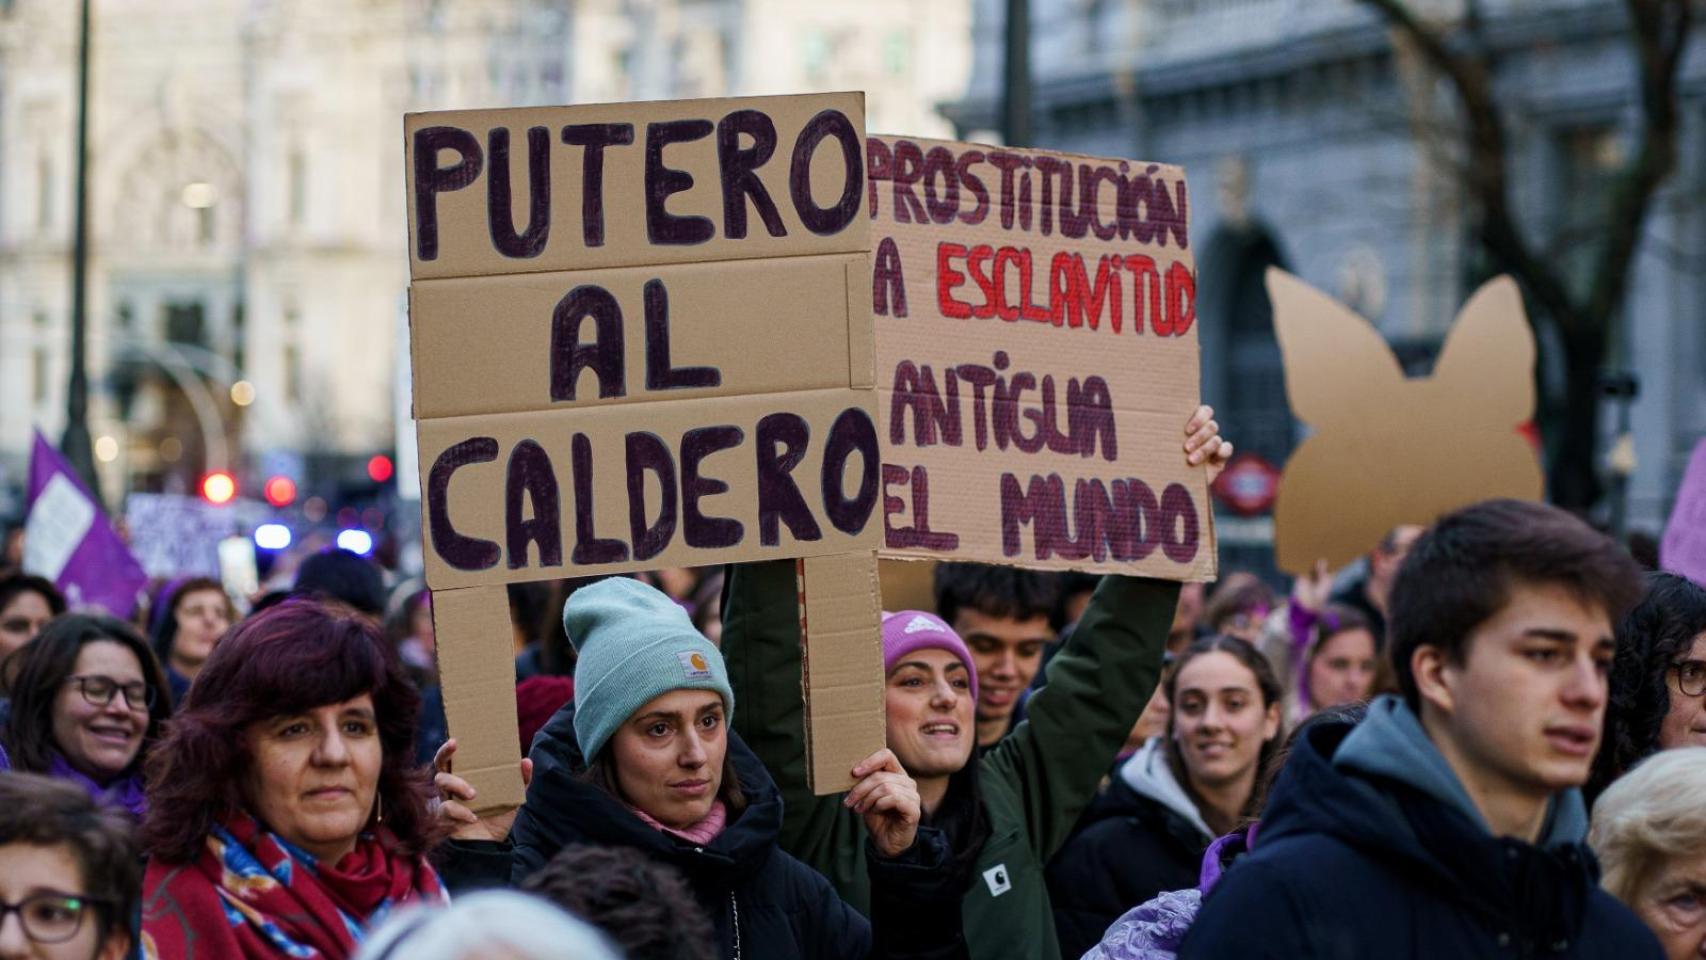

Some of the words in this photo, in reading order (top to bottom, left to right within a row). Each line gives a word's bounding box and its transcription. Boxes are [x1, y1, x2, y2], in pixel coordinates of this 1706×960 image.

[413, 109, 864, 261] PUTERO
[550, 278, 721, 402] AL
[428, 407, 879, 571] CALDERO
[1002, 472, 1199, 563] MUNDO
